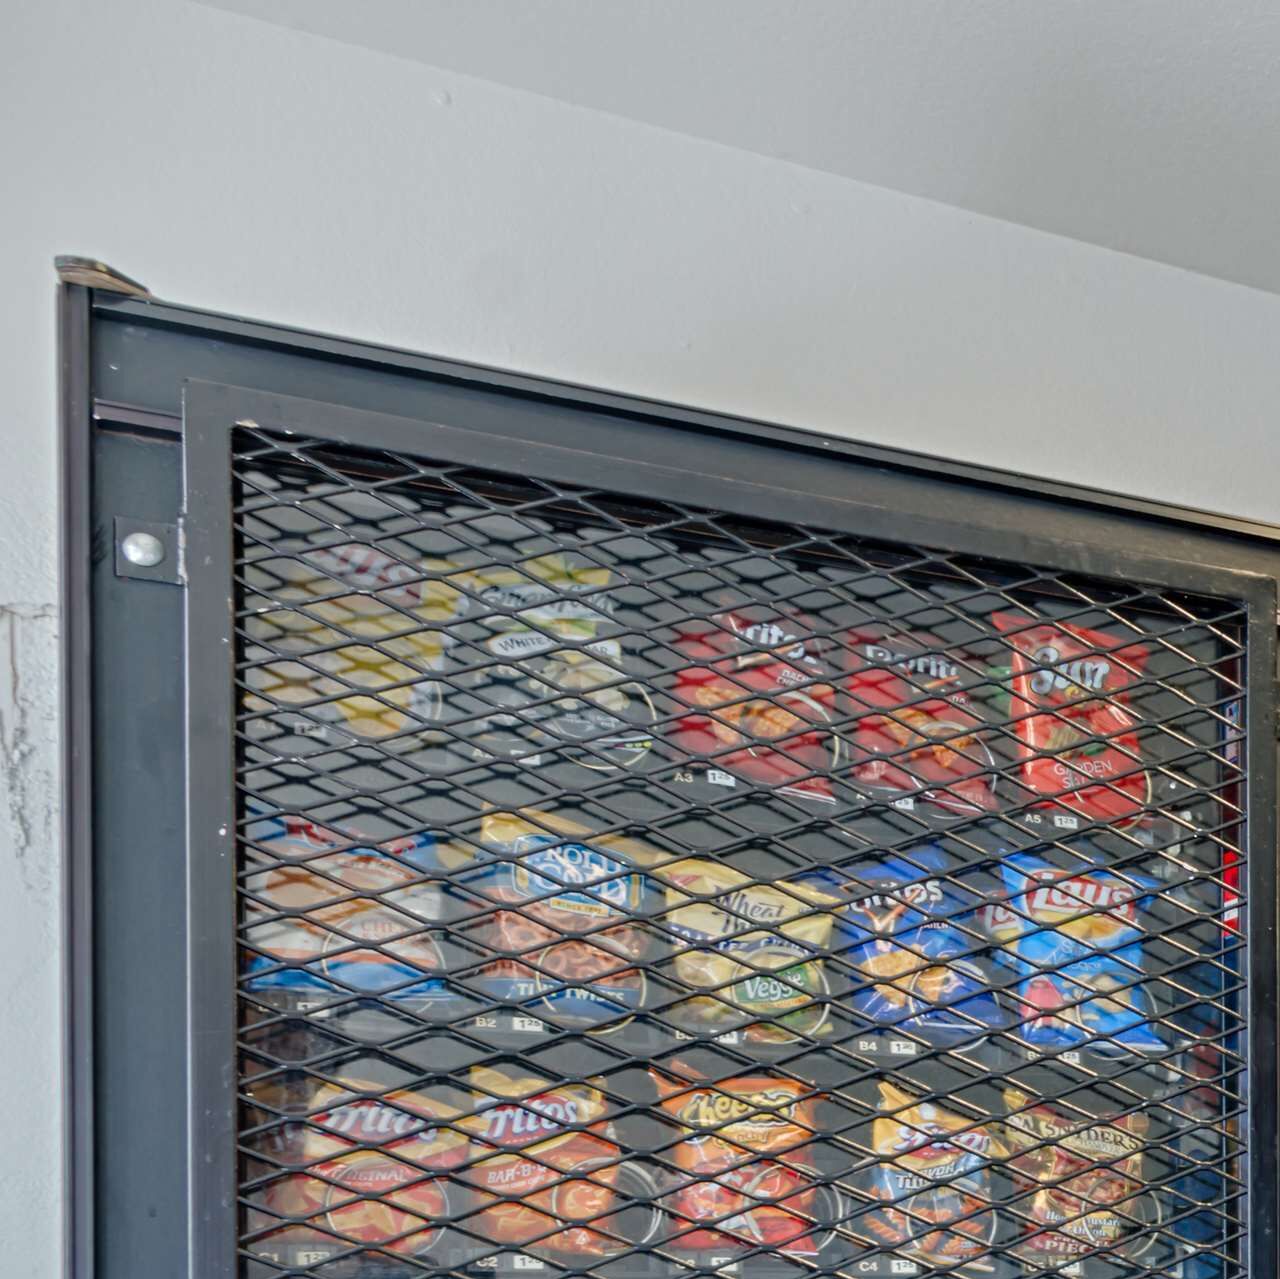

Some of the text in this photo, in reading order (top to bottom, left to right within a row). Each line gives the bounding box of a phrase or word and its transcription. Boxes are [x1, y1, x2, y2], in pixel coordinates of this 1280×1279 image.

[1030, 647, 1111, 695] Sun
[1024, 813, 1042, 823] A5
[859, 1040, 878, 1052] B4
[859, 1261, 879, 1272] C4
